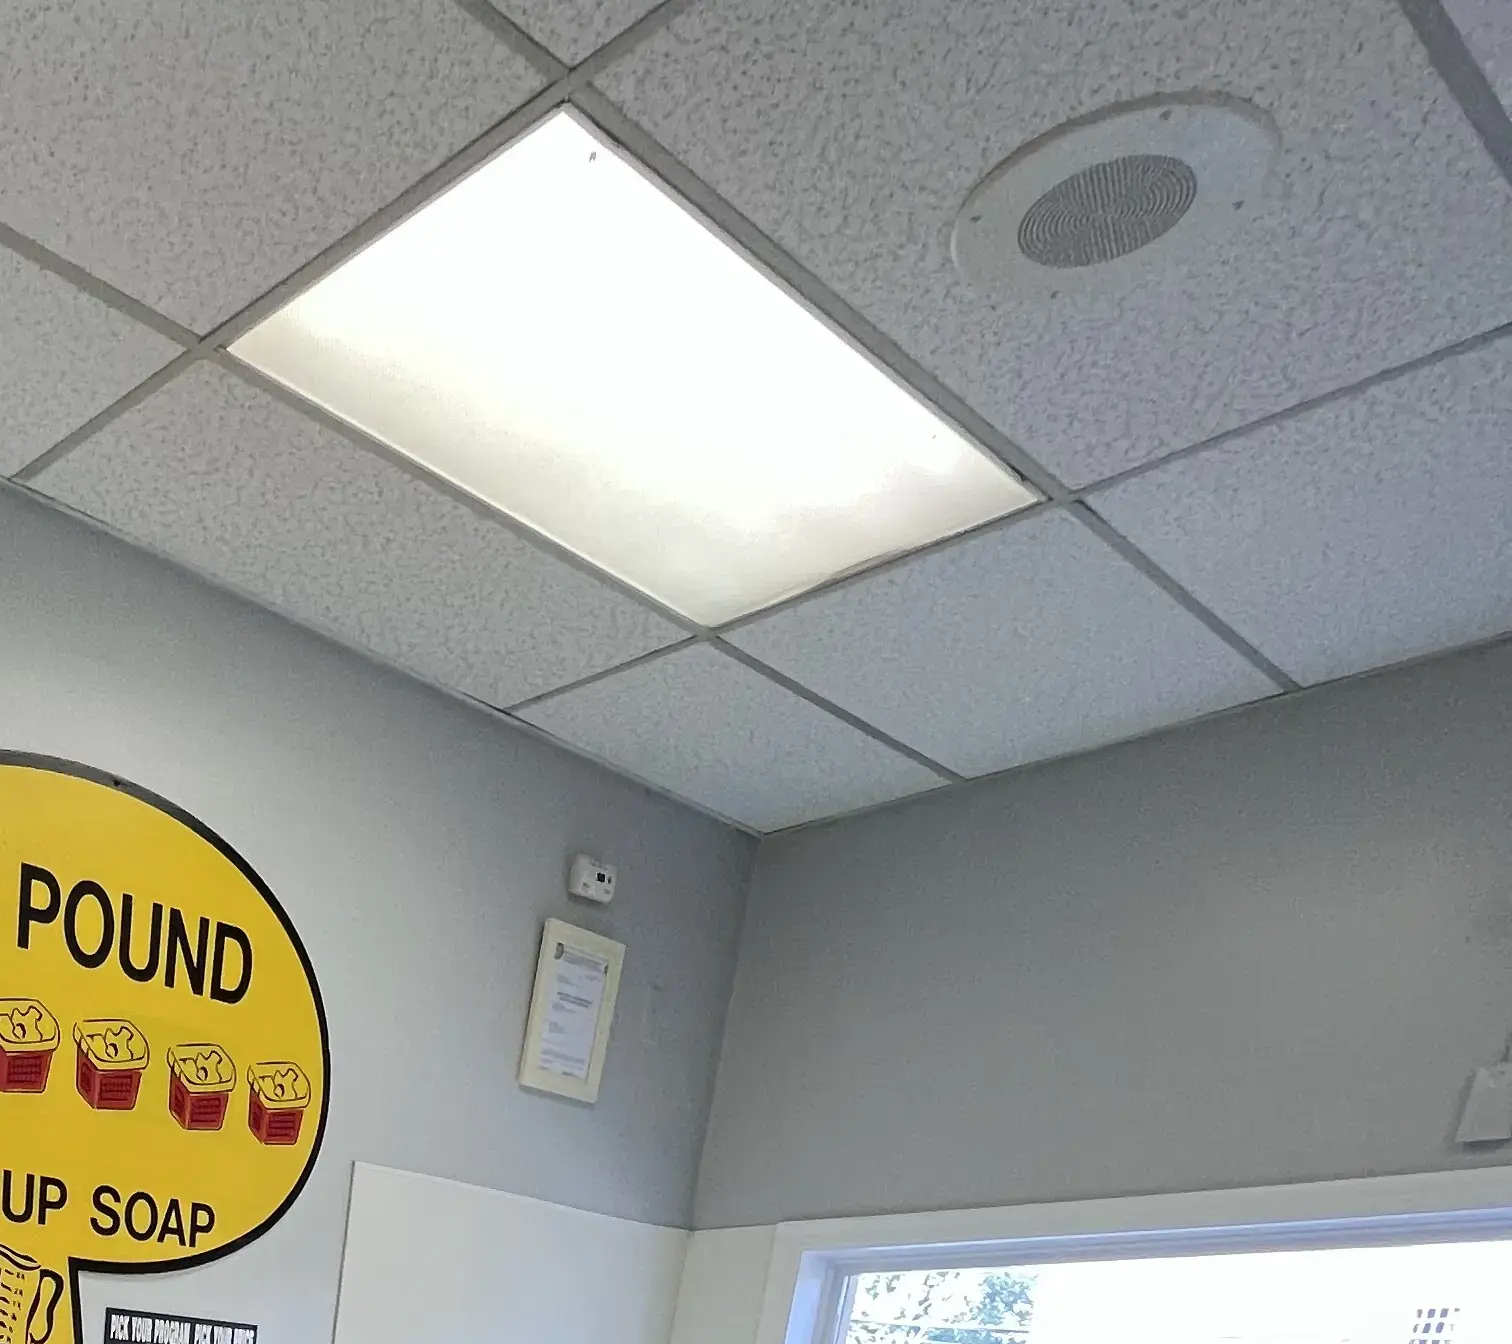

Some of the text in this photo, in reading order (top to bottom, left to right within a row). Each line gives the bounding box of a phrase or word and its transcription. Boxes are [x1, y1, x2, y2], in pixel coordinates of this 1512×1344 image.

[16, 861, 254, 1004] POUND
[90, 1185, 215, 1249] SOAP
[110, 1314, 129, 1340] PICK
[131, 1317, 152, 1342] YOUR
